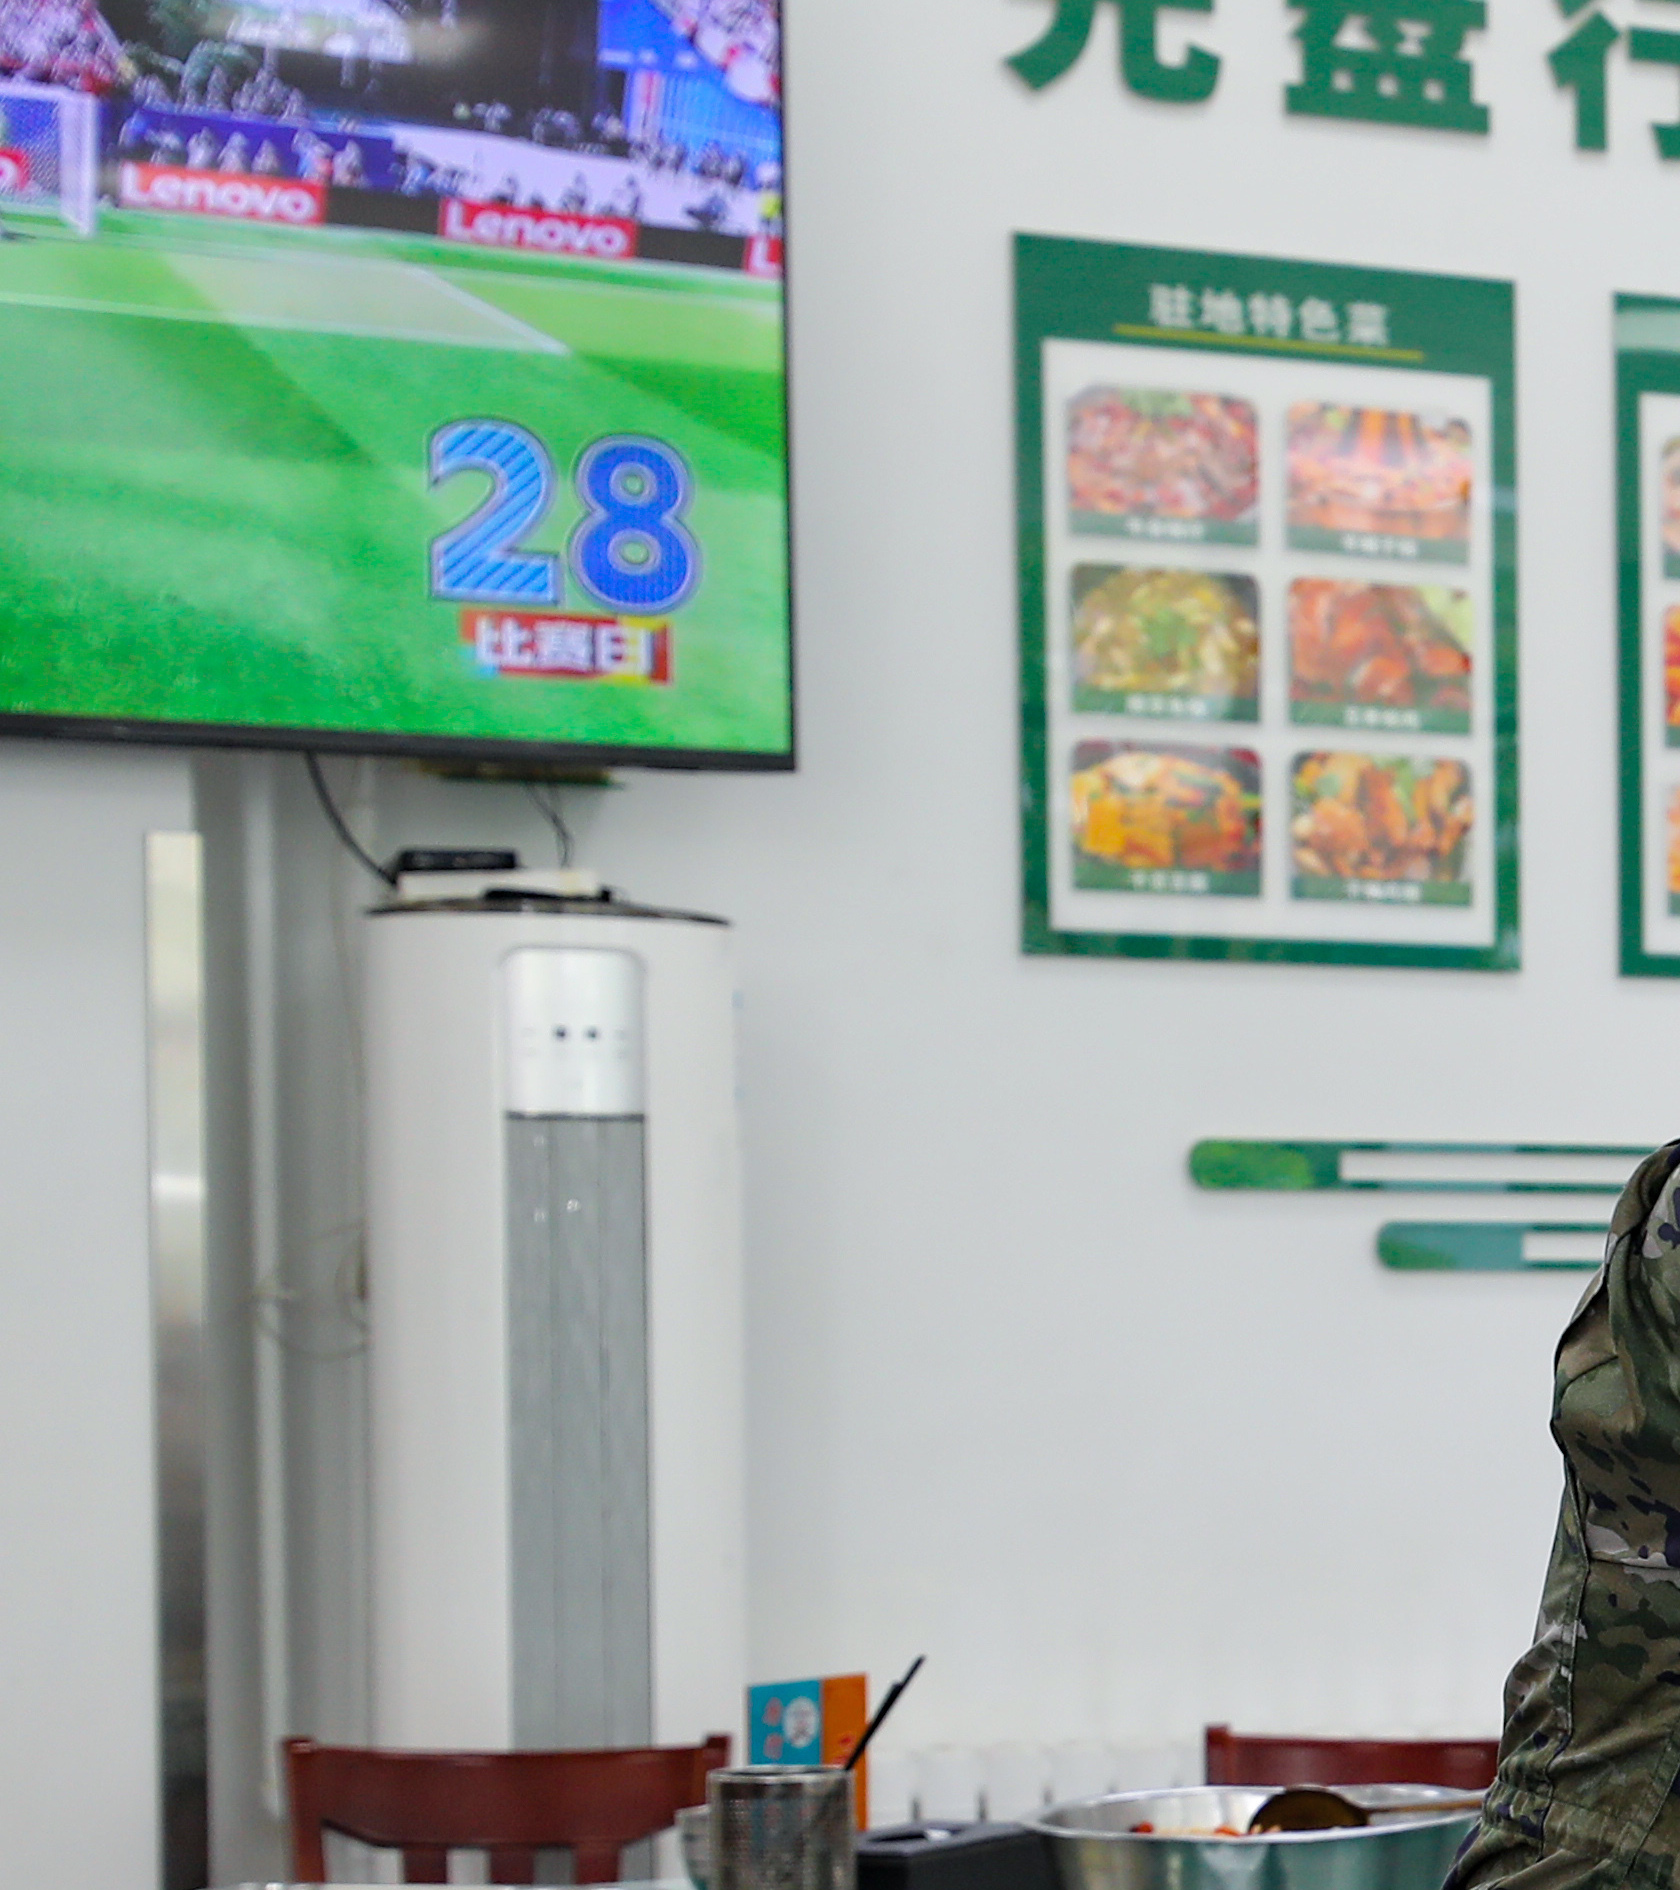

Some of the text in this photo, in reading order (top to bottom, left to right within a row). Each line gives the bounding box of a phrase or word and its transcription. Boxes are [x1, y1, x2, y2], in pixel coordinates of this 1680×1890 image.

[121, 163, 317, 222] Lenovo
[446, 202, 632, 256] Lenovo
[1148, 282, 1390, 347] 驻地特色菜
[429, 417, 699, 614] 28
